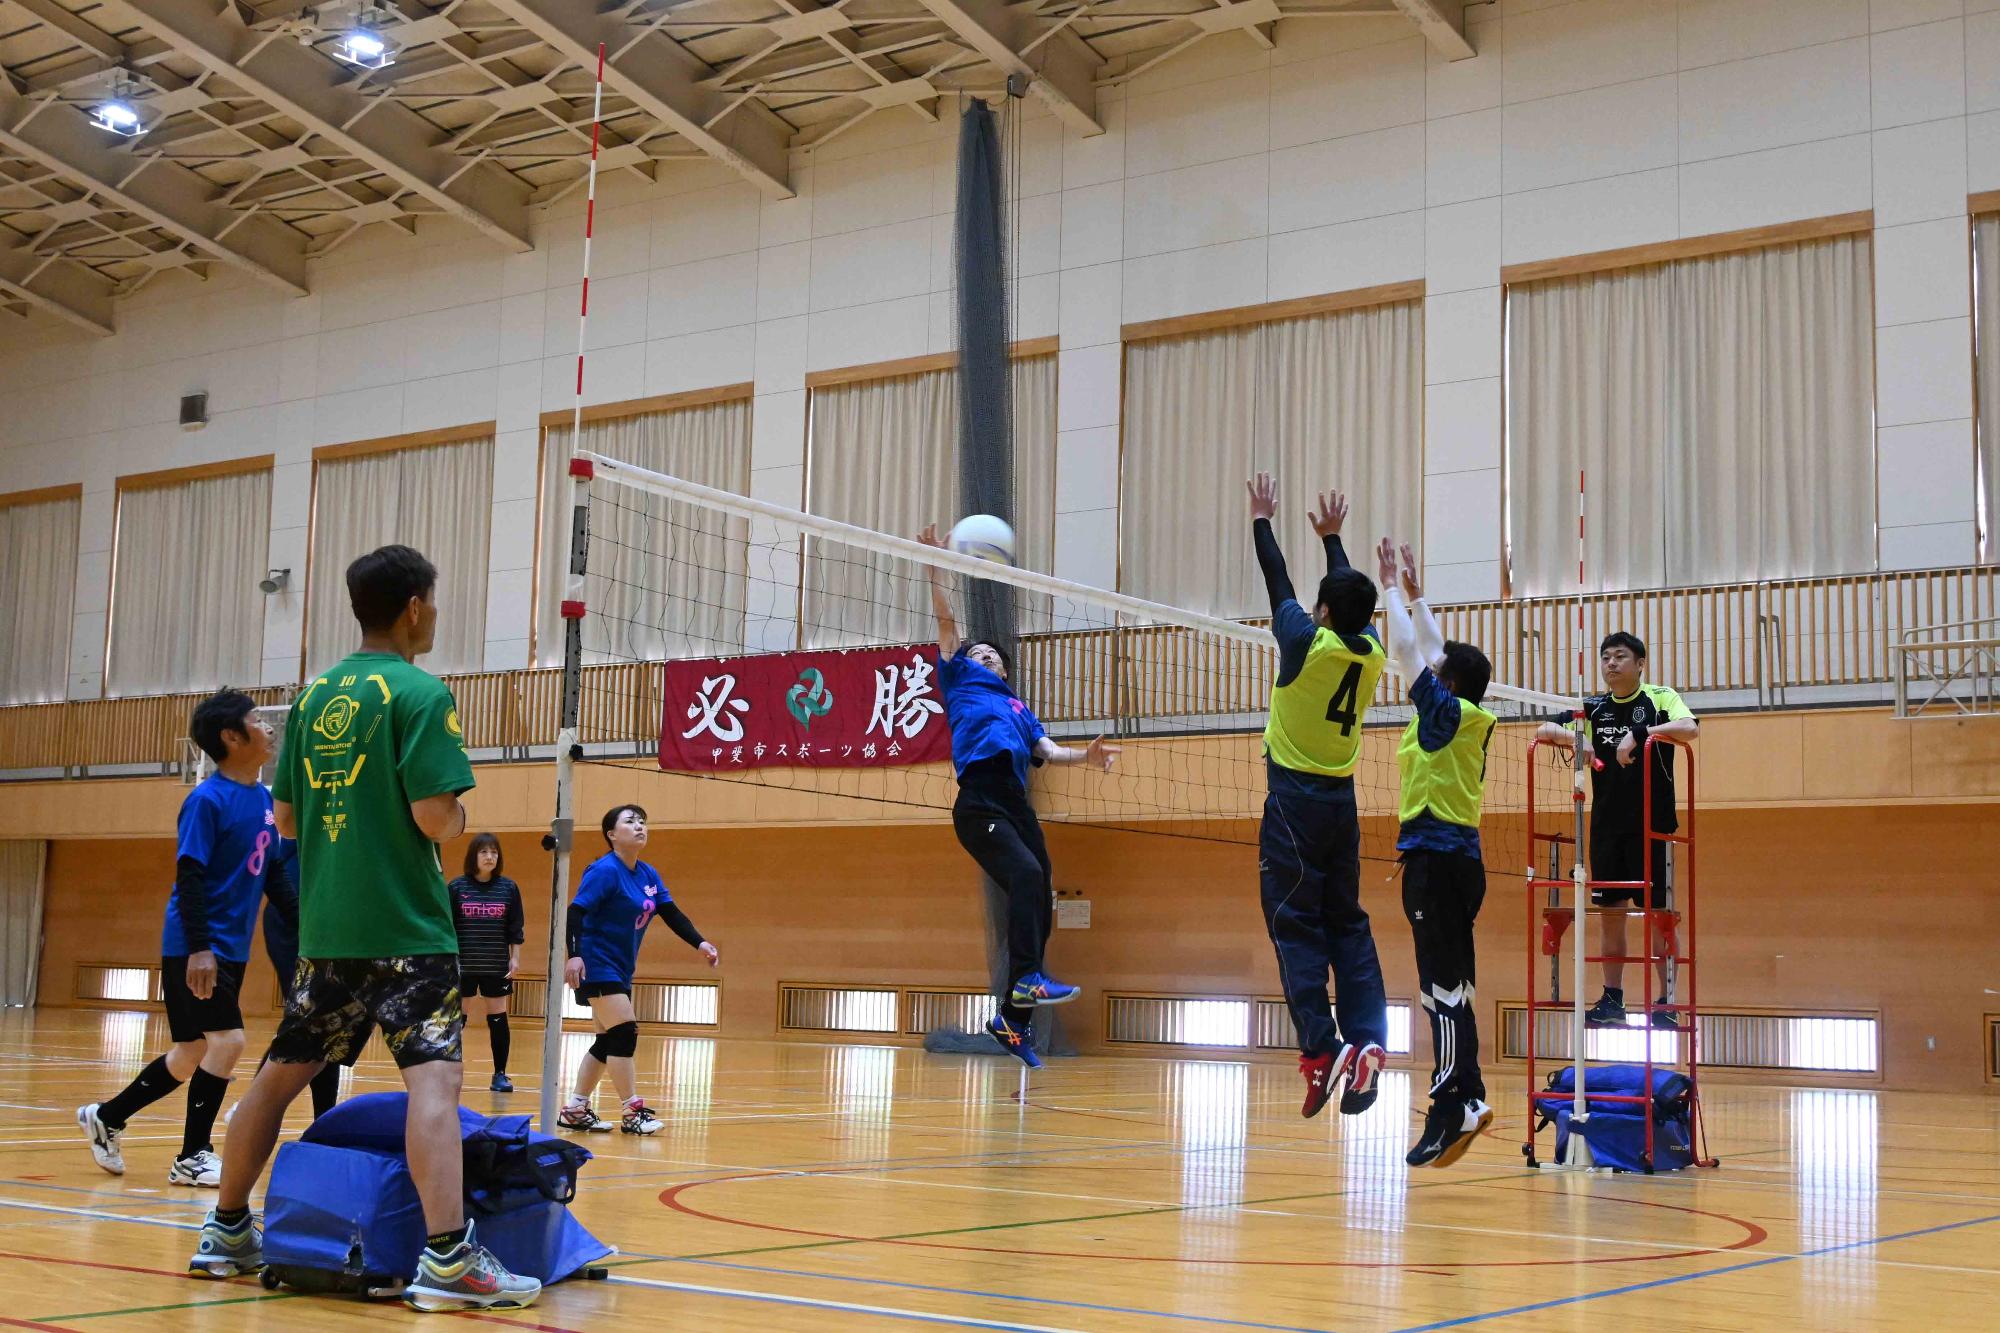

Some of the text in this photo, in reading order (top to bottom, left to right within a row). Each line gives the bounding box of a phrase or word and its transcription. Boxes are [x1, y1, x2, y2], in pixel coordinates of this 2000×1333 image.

[338, 675, 357, 687] 10
[682, 653, 945, 742] 必 勝
[1325, 661, 1363, 737] 4
[1596, 725, 1632, 735] PENA
[711, 740, 903, 765] 甲斐市スポーツ協会
[247, 830, 271, 876] 8
[634, 899, 656, 930] 3
